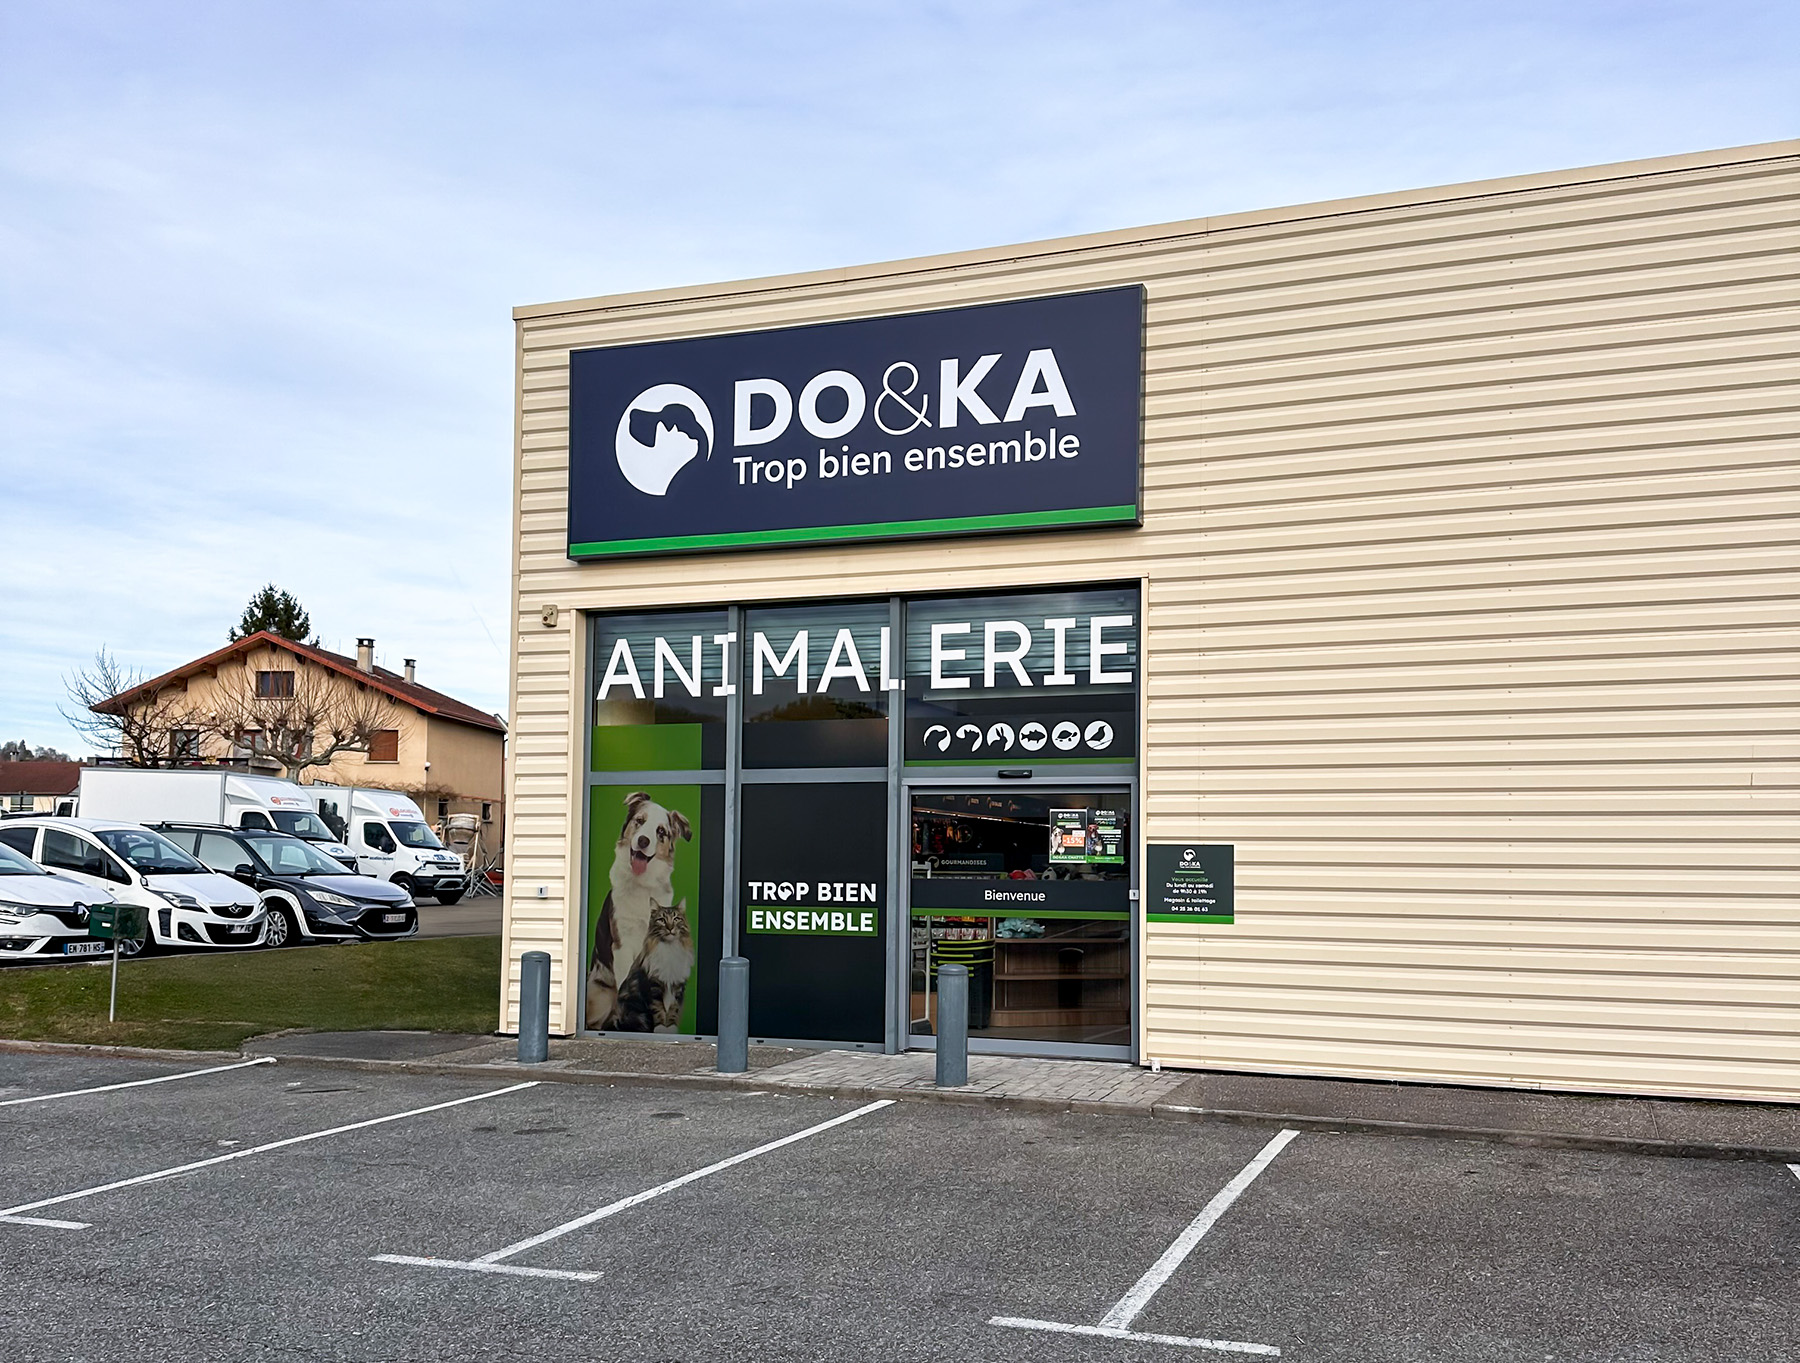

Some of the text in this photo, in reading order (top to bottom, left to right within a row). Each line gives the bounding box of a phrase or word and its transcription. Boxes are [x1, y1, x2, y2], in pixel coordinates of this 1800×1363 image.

[733, 348, 1077, 448] DO&KA
[733, 427, 1081, 489] Trop bien ensemble
[596, 614, 1134, 701] ANIMALERIE
[748, 881, 877, 902] TROP BIEN
[984, 889, 1046, 902] Bienvenue
[751, 910, 873, 932] ENSEMBLE
